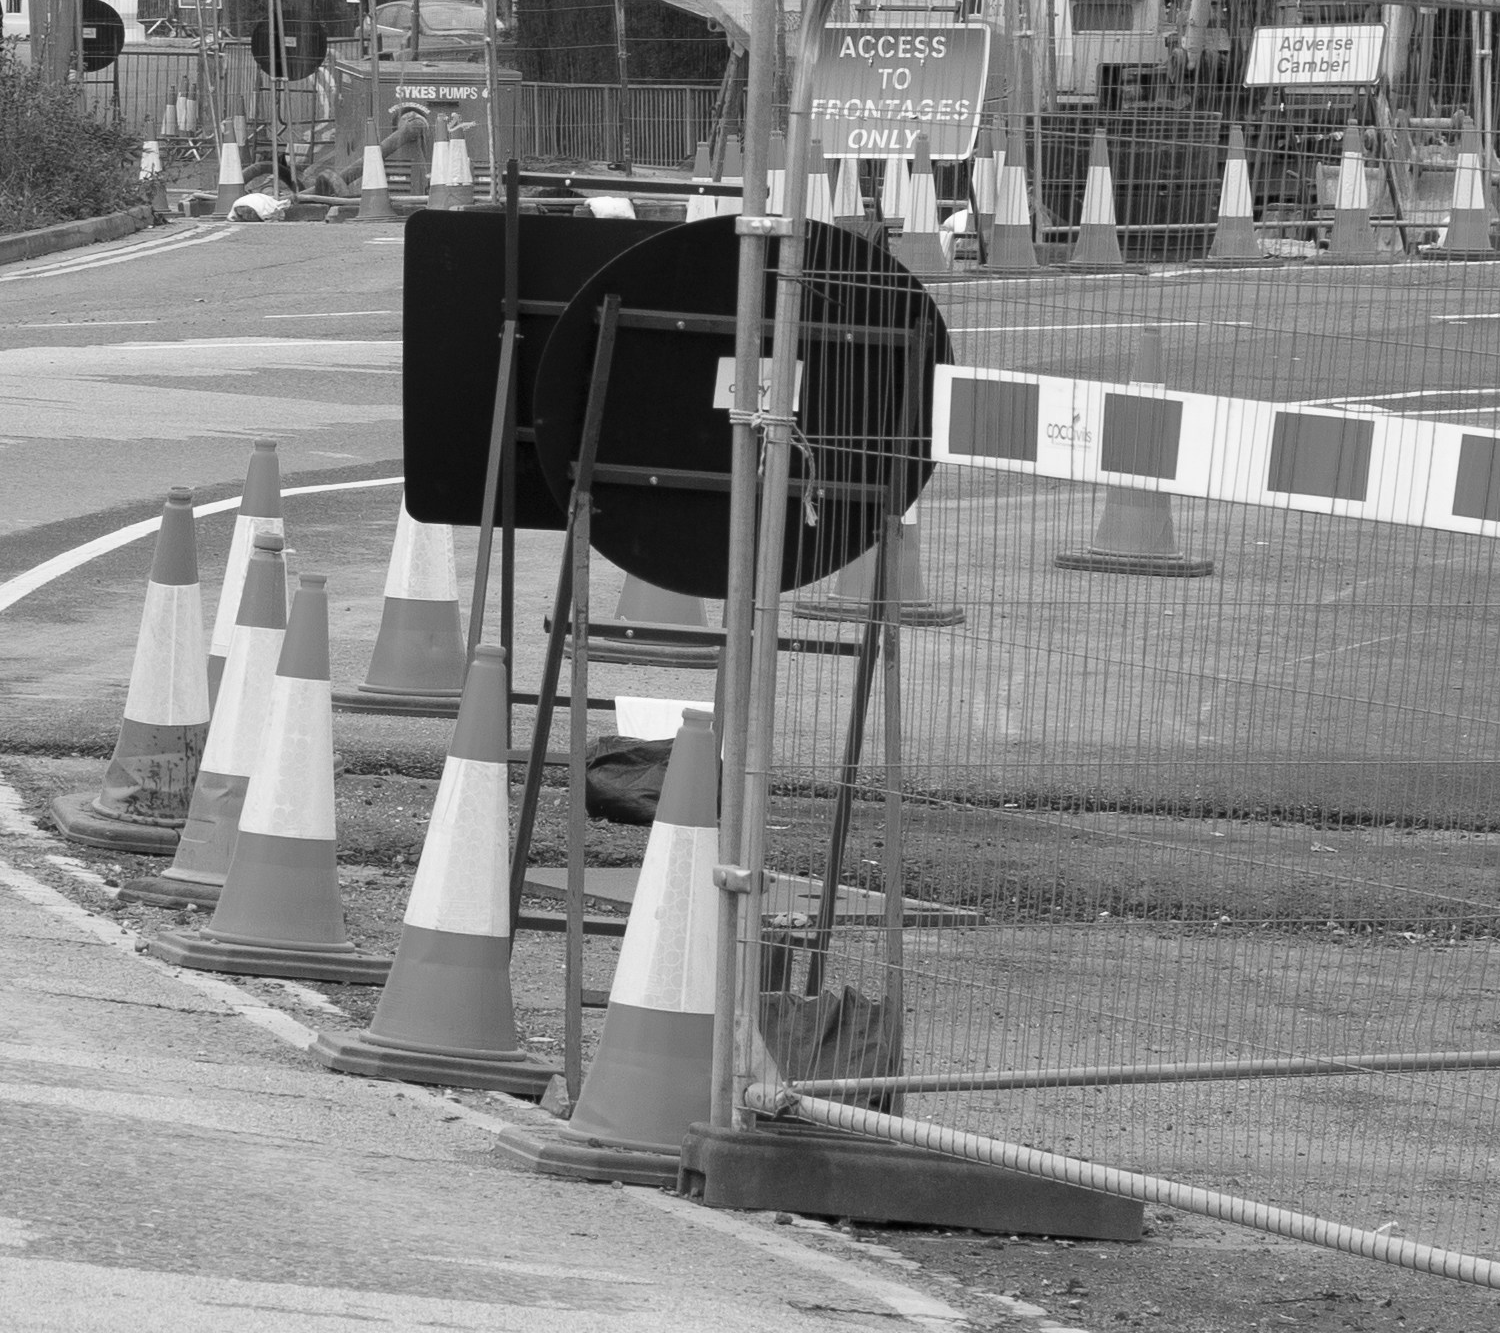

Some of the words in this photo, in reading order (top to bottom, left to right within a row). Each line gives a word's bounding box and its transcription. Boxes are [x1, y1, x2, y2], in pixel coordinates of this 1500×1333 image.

[839, 35, 947, 58] ACCESS
[1279, 36, 1354, 52] Adverse
[1277, 57, 1350, 74] Camber
[878, 67, 912, 90] TO
[395, 85, 437, 99] SYKES
[439, 86, 478, 100] PUMPS
[811, 98, 970, 121] FRONTAGES
[847, 128, 921, 149] ONLY
